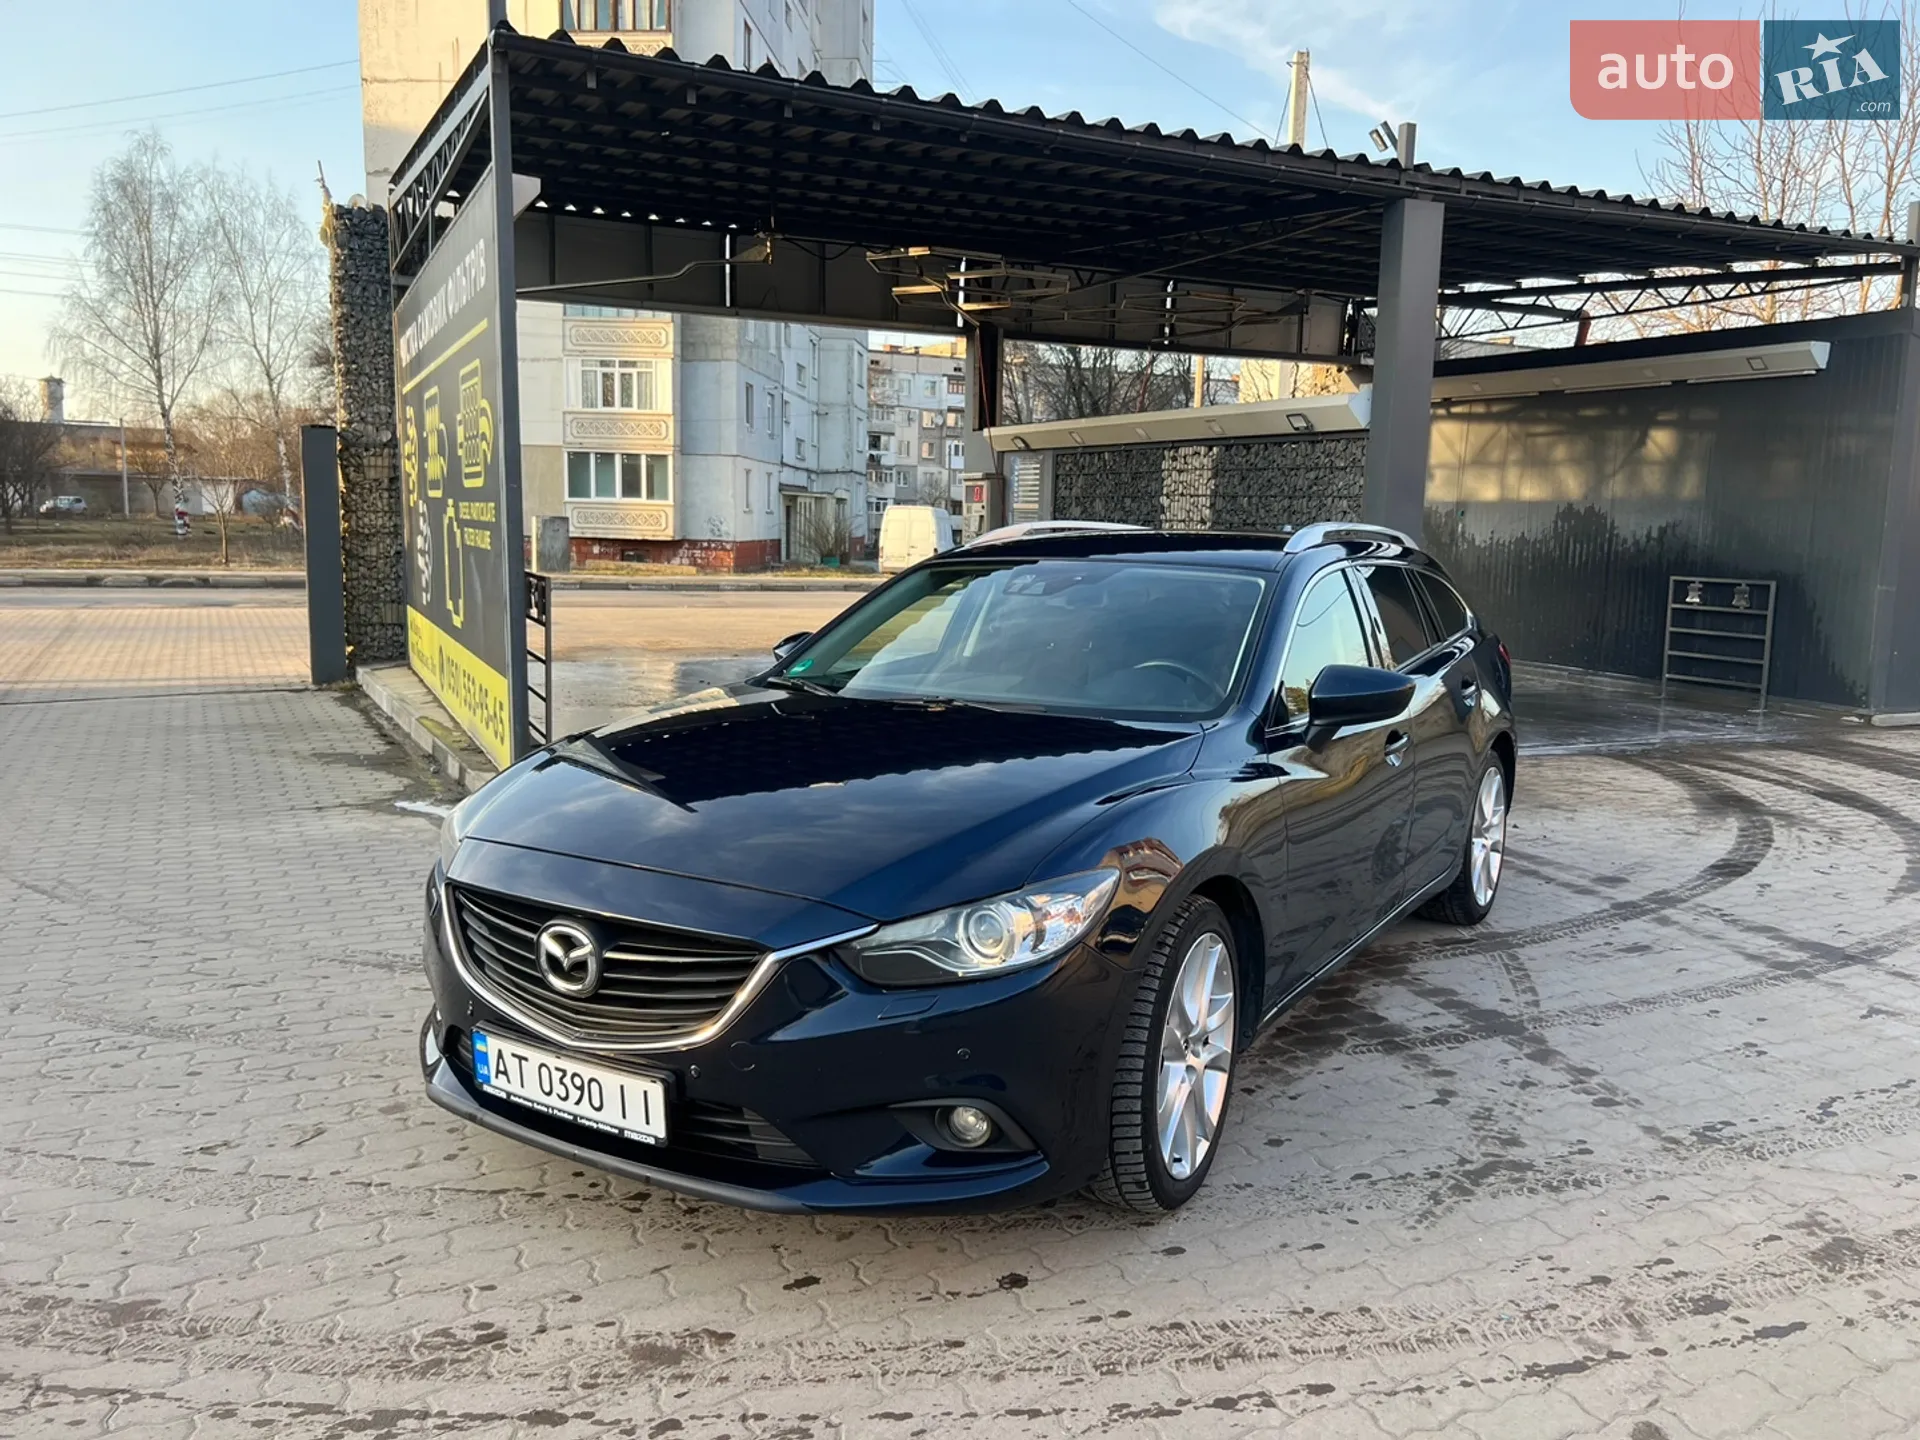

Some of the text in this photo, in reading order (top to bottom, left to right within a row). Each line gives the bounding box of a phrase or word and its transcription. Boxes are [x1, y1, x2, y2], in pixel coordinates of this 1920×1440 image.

[462, 669, 506, 746] 553-95-65
[477, 1063, 489, 1077] UA
[494, 1048, 529, 1089] AT
[537, 1063, 604, 1112] 0390
[623, 1130, 656, 1145] mazda
